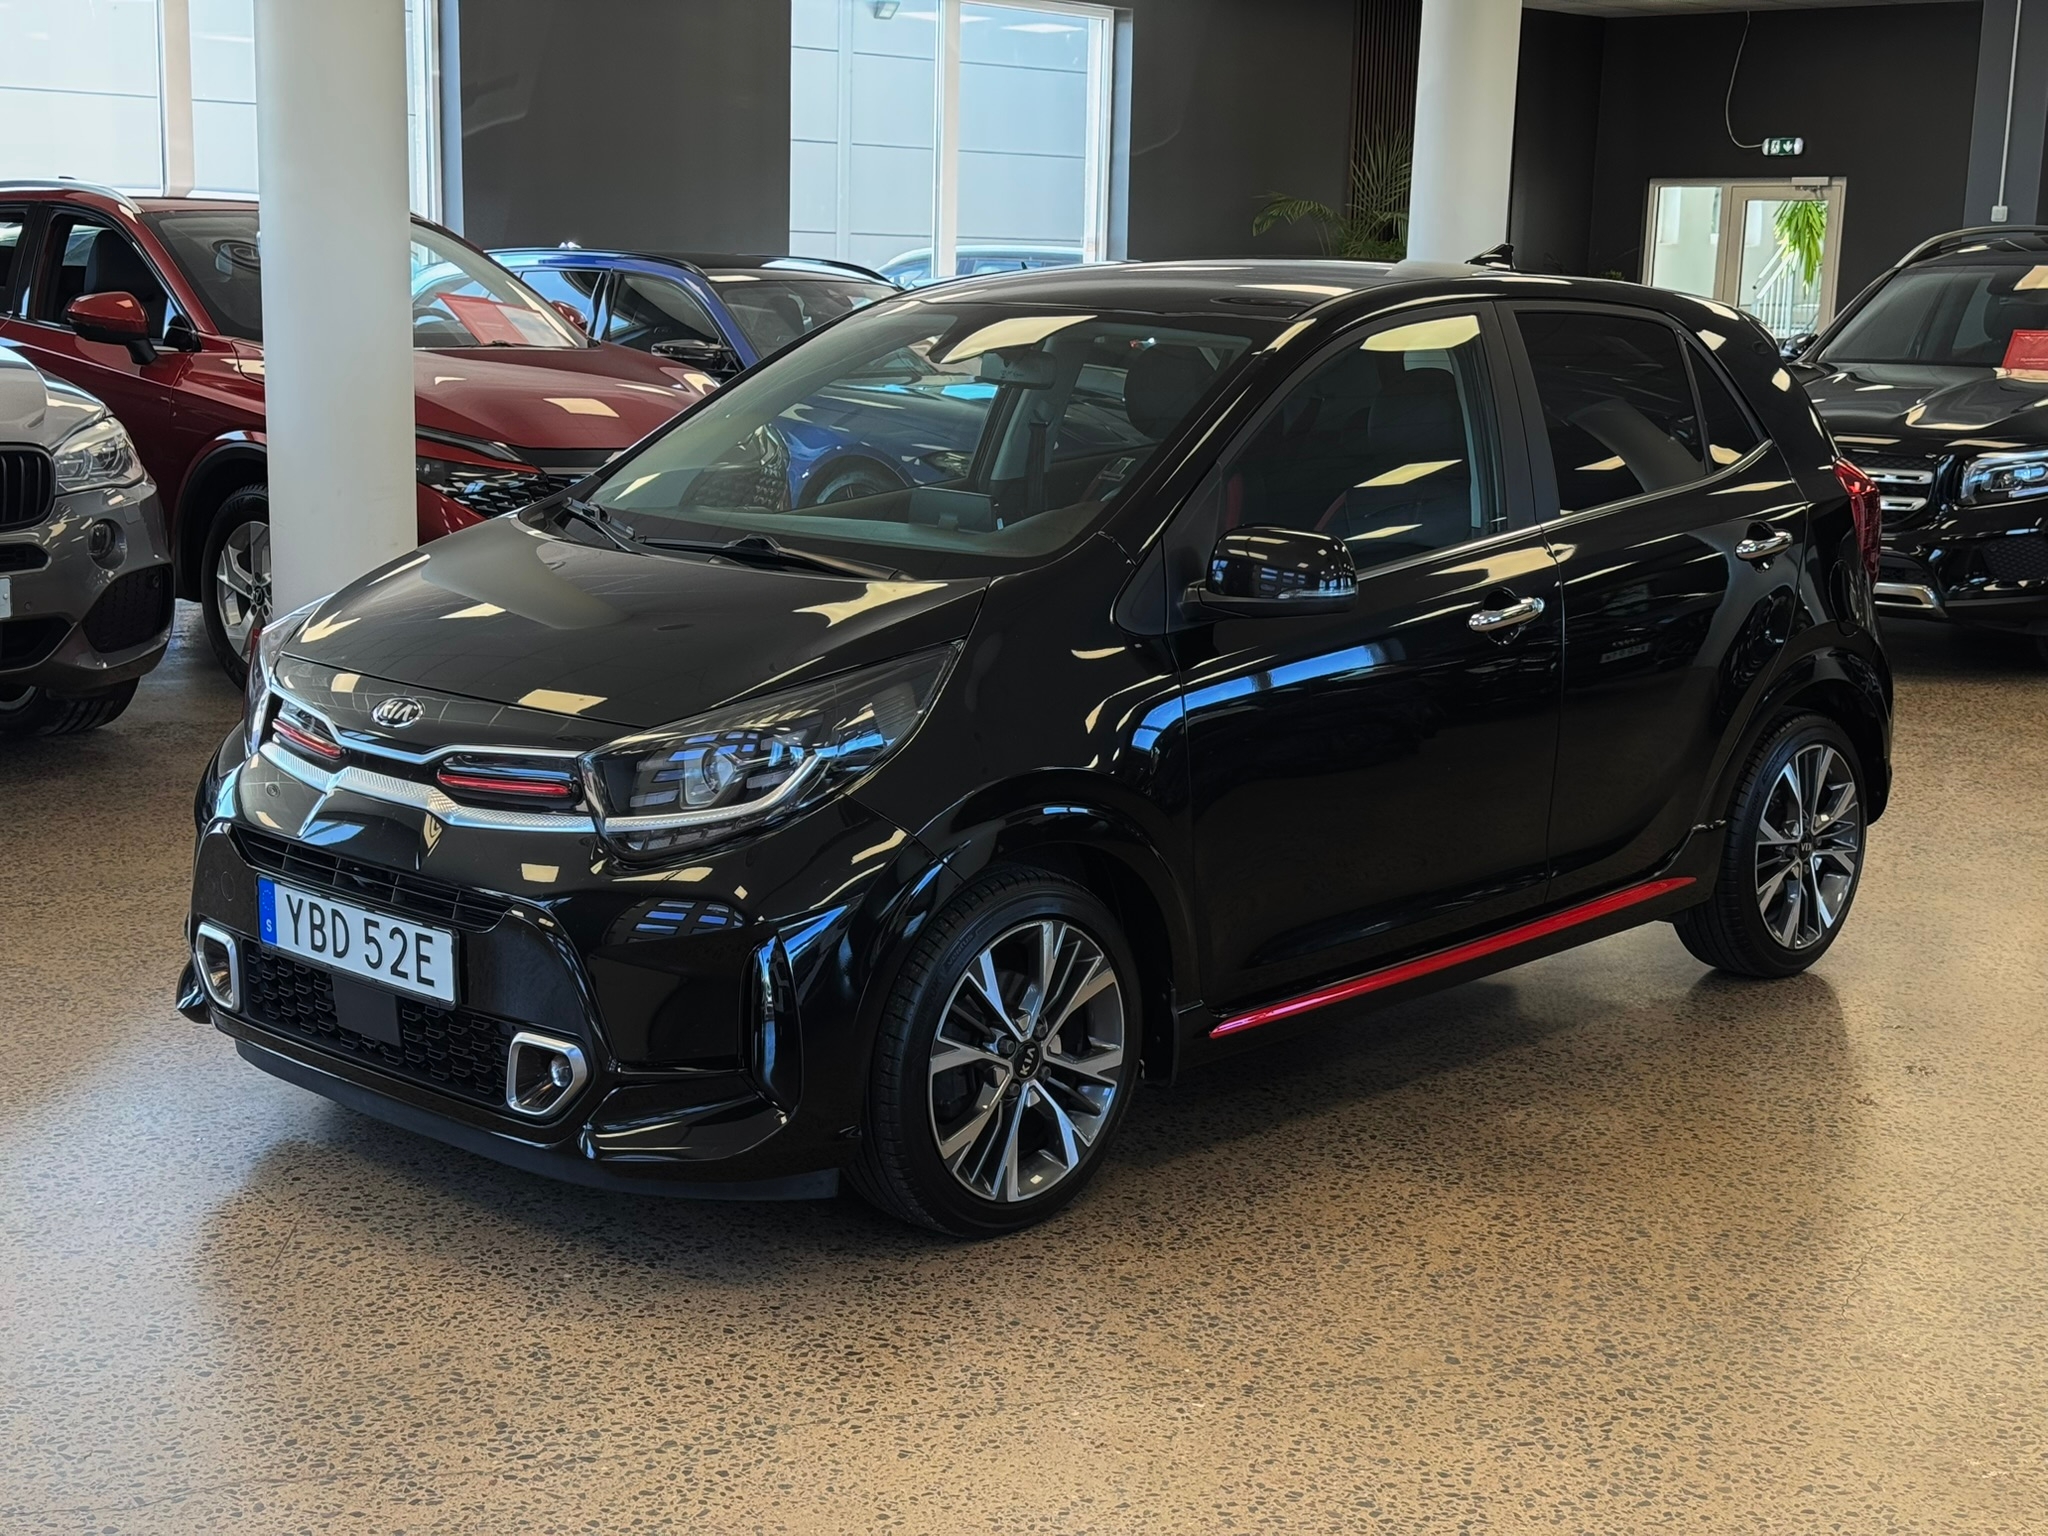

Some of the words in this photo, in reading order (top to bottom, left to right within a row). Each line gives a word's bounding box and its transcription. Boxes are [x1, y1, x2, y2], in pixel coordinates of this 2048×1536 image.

[378, 701, 414, 722] KIA
[266, 919, 273, 933] S
[286, 894, 350, 959] YBD
[363, 918, 435, 988] 52E
[1019, 1047, 1036, 1076] KIA
